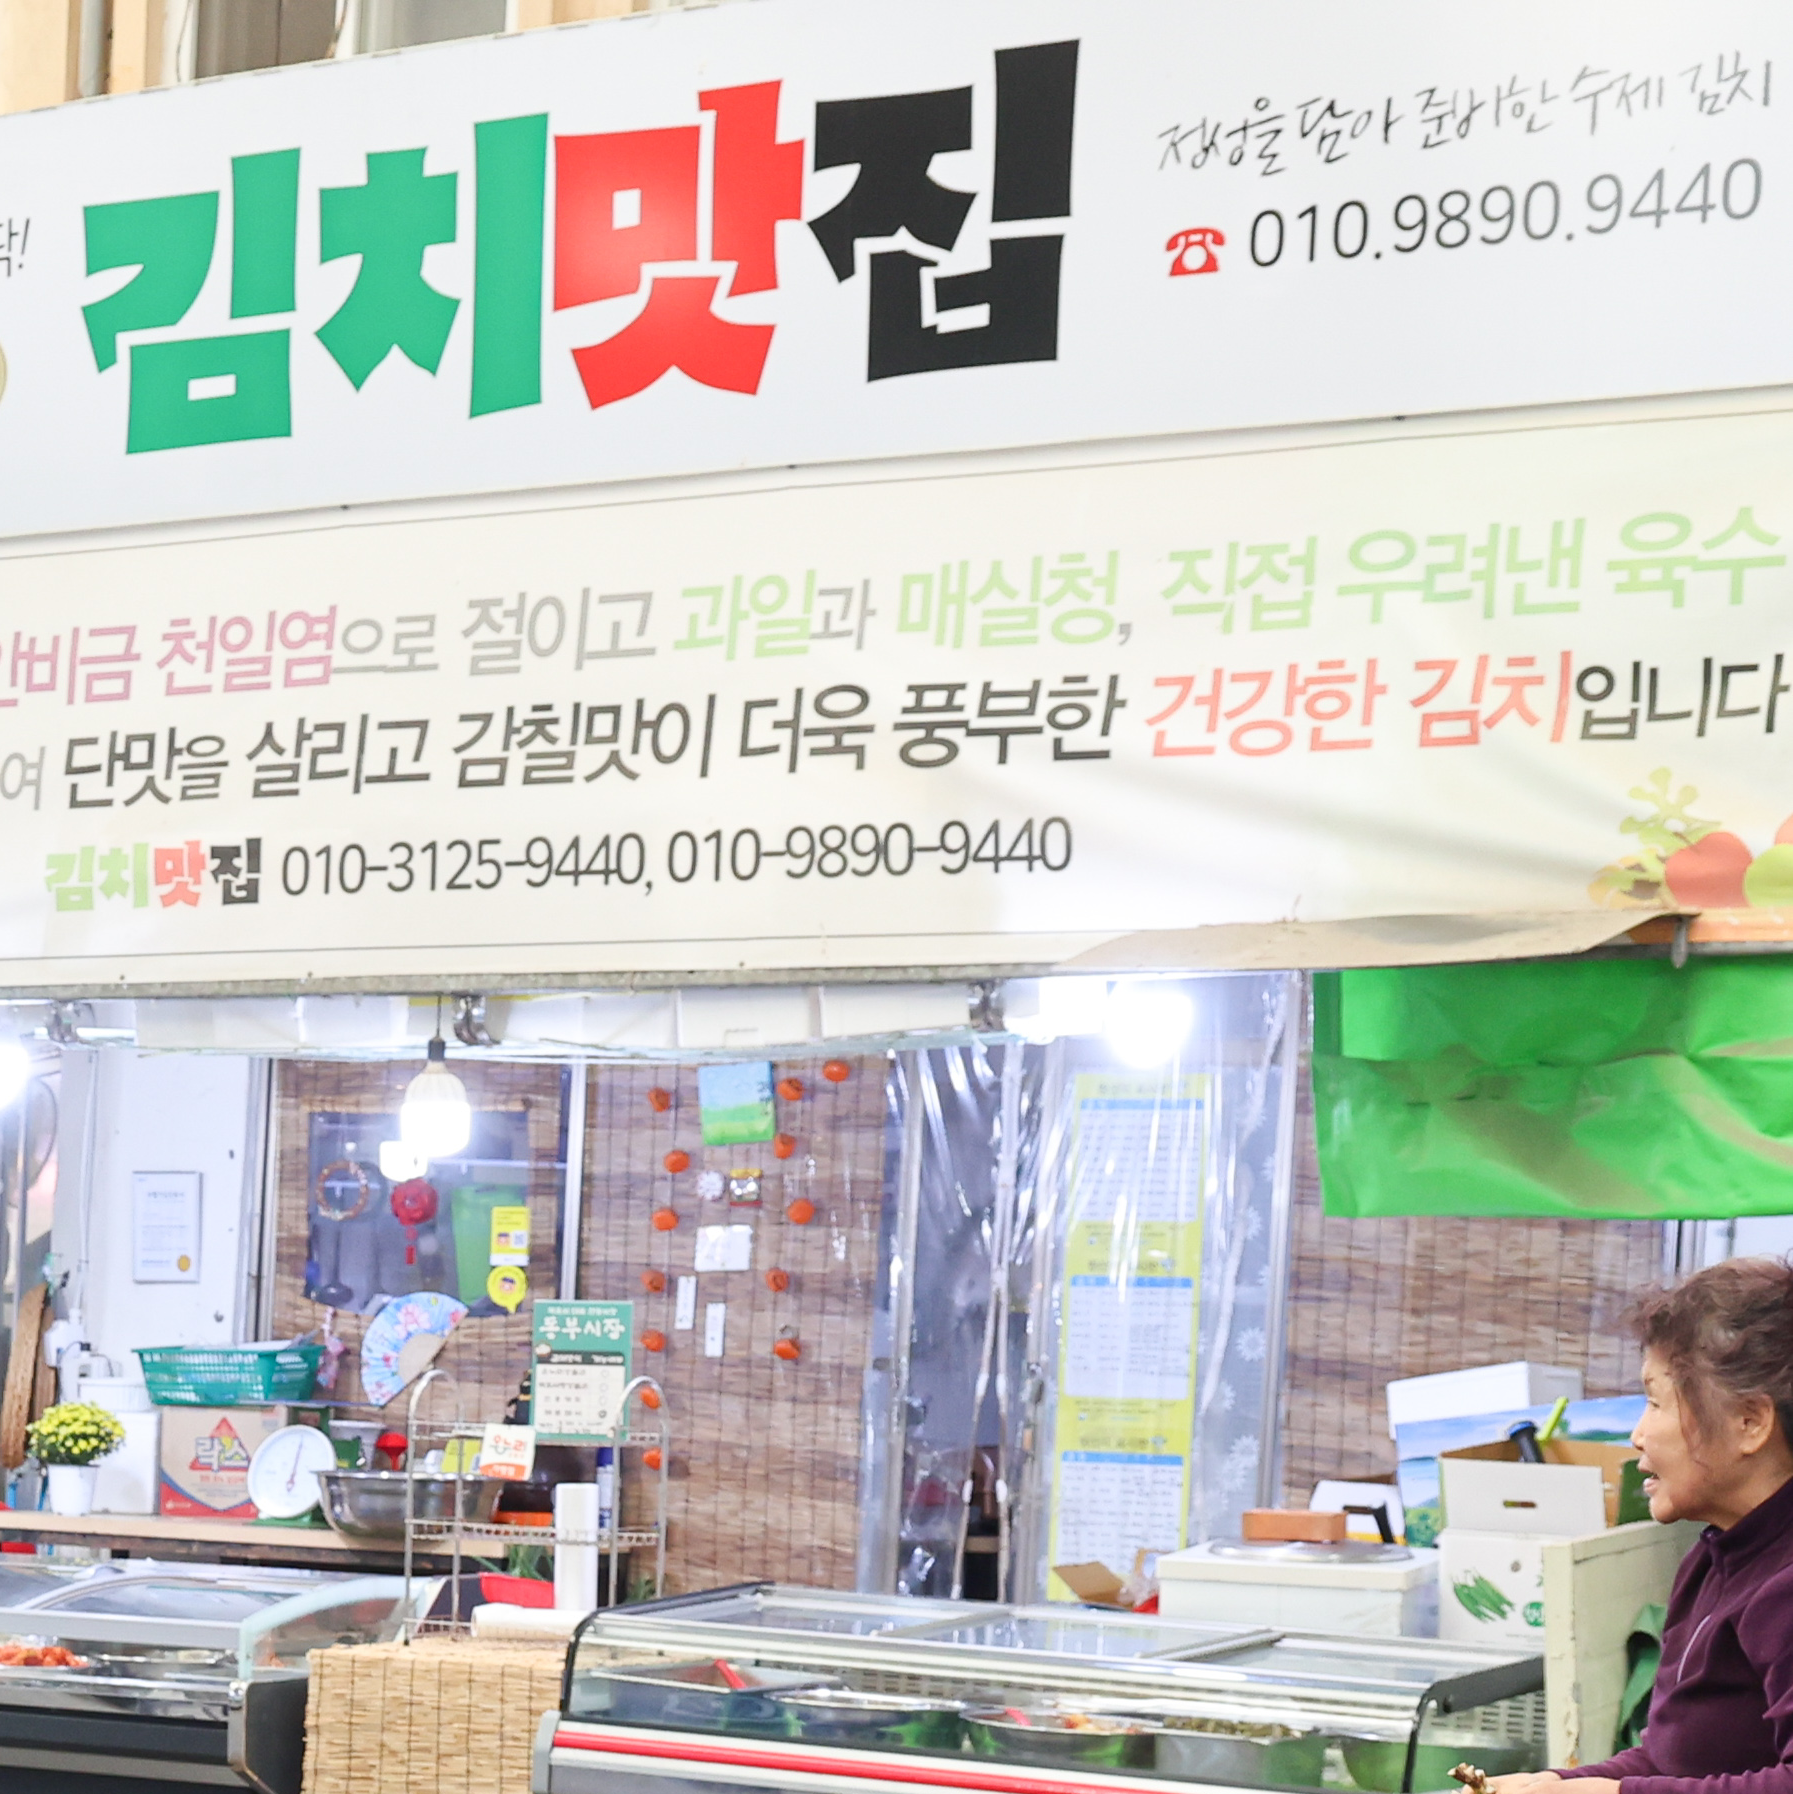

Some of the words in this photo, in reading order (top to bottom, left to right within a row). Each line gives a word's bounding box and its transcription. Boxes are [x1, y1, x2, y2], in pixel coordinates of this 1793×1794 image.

[1157, 96, 1288, 177] 정성을
[1296, 96, 1403, 165] 담아
[1413, 73, 1555, 150] 준비한
[1570, 64, 1665, 136] 수제
[1678, 50, 1774, 116] 김치
[81, 38, 1081, 455] 김치맛집
[1249, 157, 1763, 268] 010.9890.9440
[155, 603, 440, 699] 천일염으로
[459, 584, 657, 677] 절이고
[672, 567, 877, 662] 과일과
[895, 547, 1134, 651] 매실청,
[1159, 534, 1319, 638] 직접
[1335, 516, 1587, 626] 우려낸
[1605, 505, 1788, 609] 육수
[61, 725, 231, 810] 단맛을
[244, 712, 432, 799] 살리고
[450, 692, 718, 789] 감칠맛이
[736, 682, 877, 776] 더욱
[892, 671, 1127, 772] 풍부한
[1142, 652, 1388, 760] 건강한
[1410, 648, 1790, 751] 김치입니다
[44, 836, 263, 912] 김치맛집
[280, 832, 654, 897] 010-3125-9440,
[667, 815, 1074, 883] 010-9890-9440
